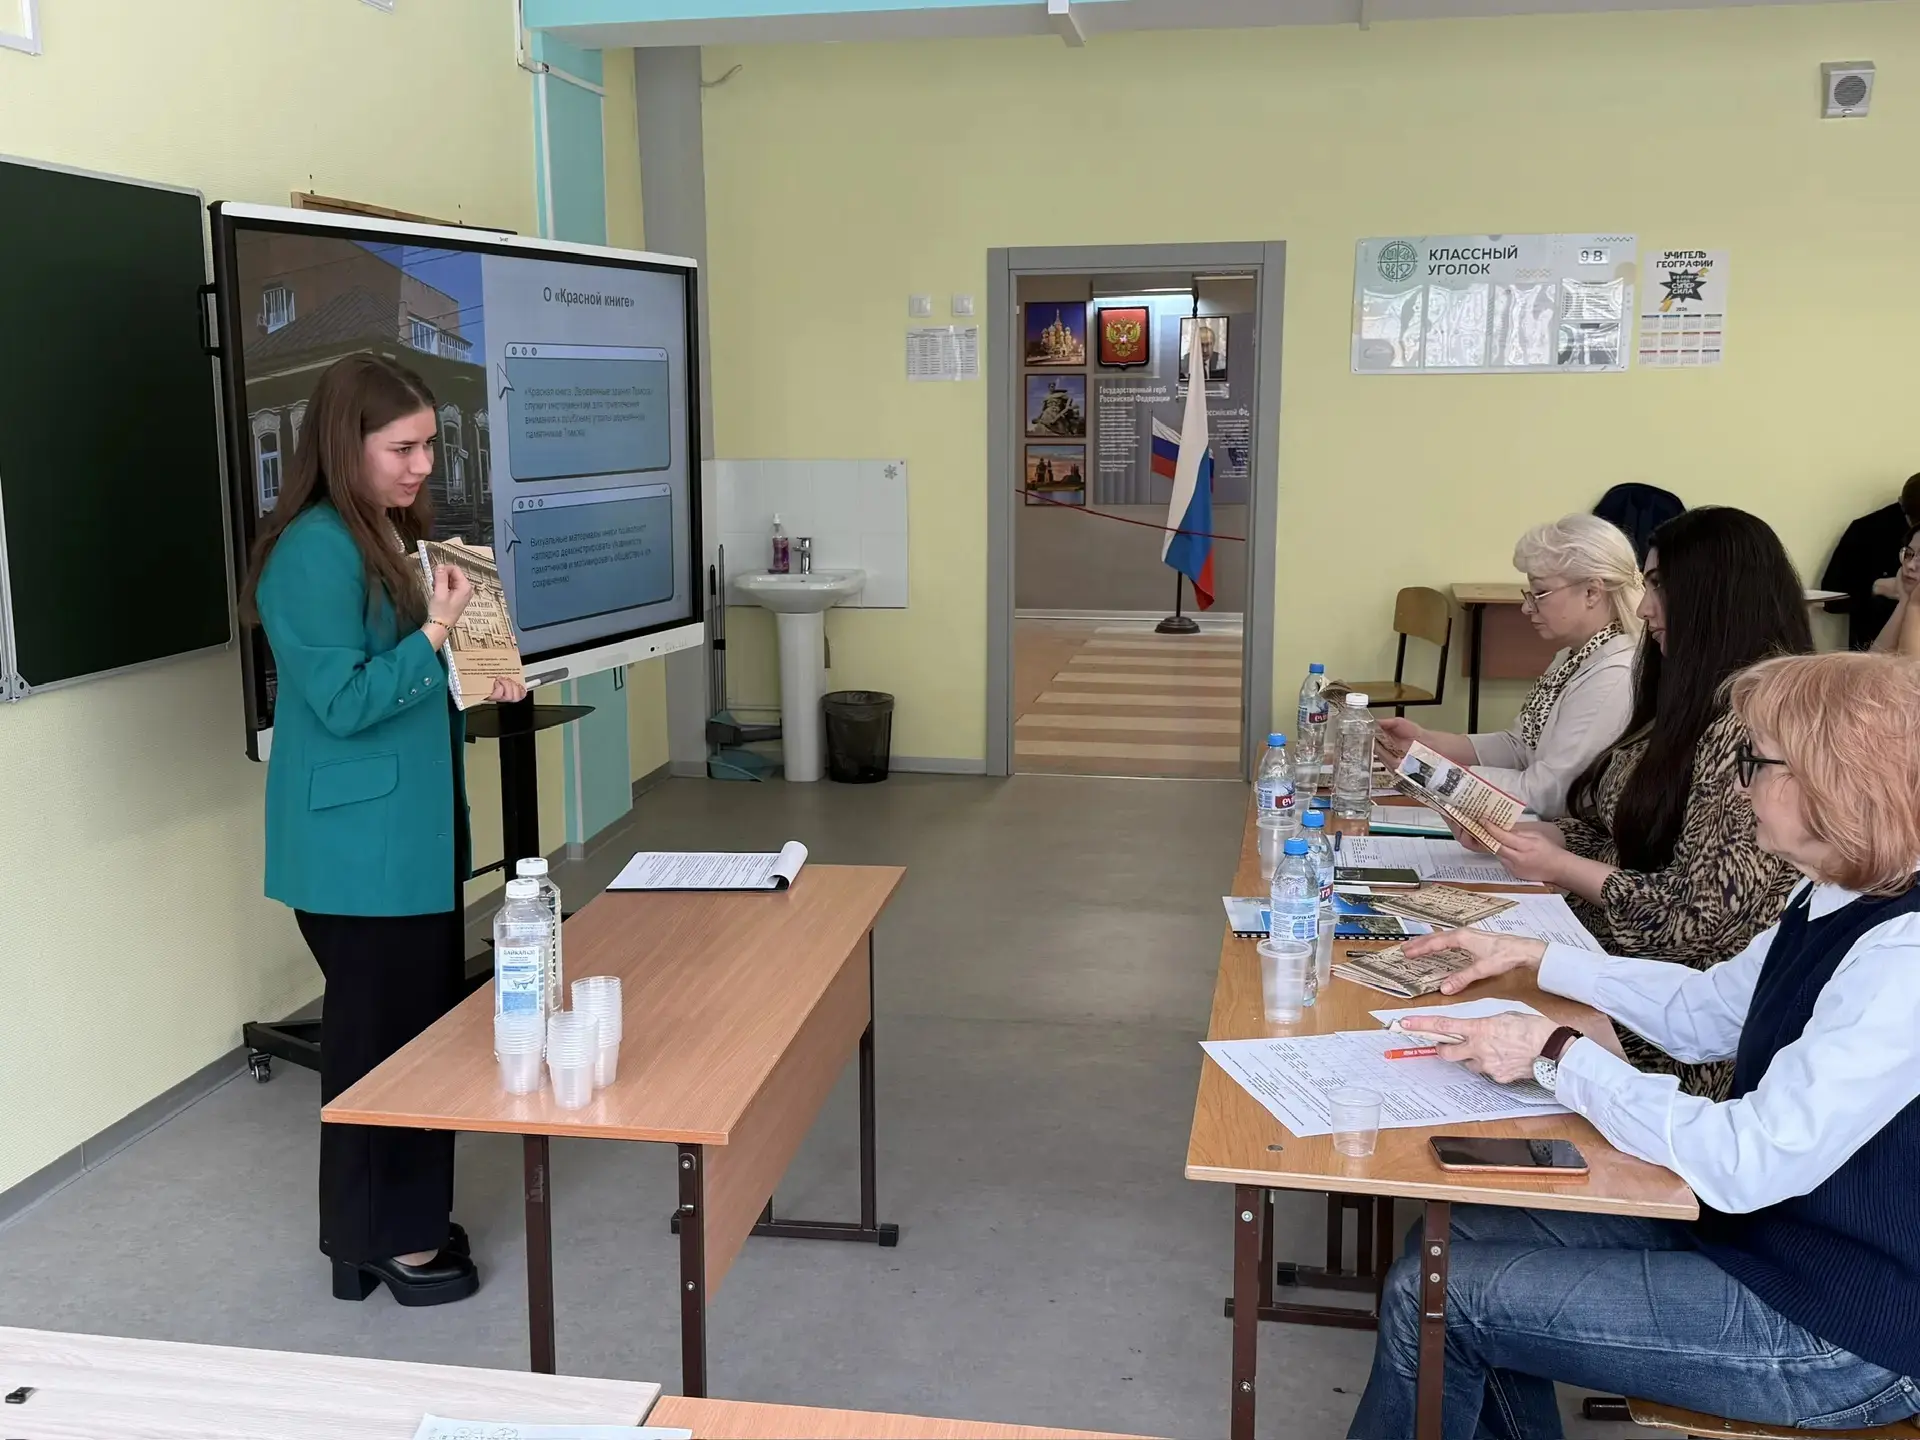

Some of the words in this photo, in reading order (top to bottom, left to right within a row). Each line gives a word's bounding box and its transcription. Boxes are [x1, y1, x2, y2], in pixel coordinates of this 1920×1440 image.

[1429, 246, 1518, 261] КЛАССНЫЙ
[1581, 250, 1589, 262] 9
[1593, 250, 1603, 262] В
[1663, 250, 1707, 260] УЧИТЕЛЬ
[1428, 263, 1490, 276] УГОЛОК
[1656, 260, 1714, 268] ГЕОГРАФИИ
[543, 286, 552, 302] О
[554, 287, 602, 307] «Красной
[604, 294, 635, 308] книге»
[1099, 394, 1134, 403] Российской
[1206, 407, 1238, 416] оссийской
